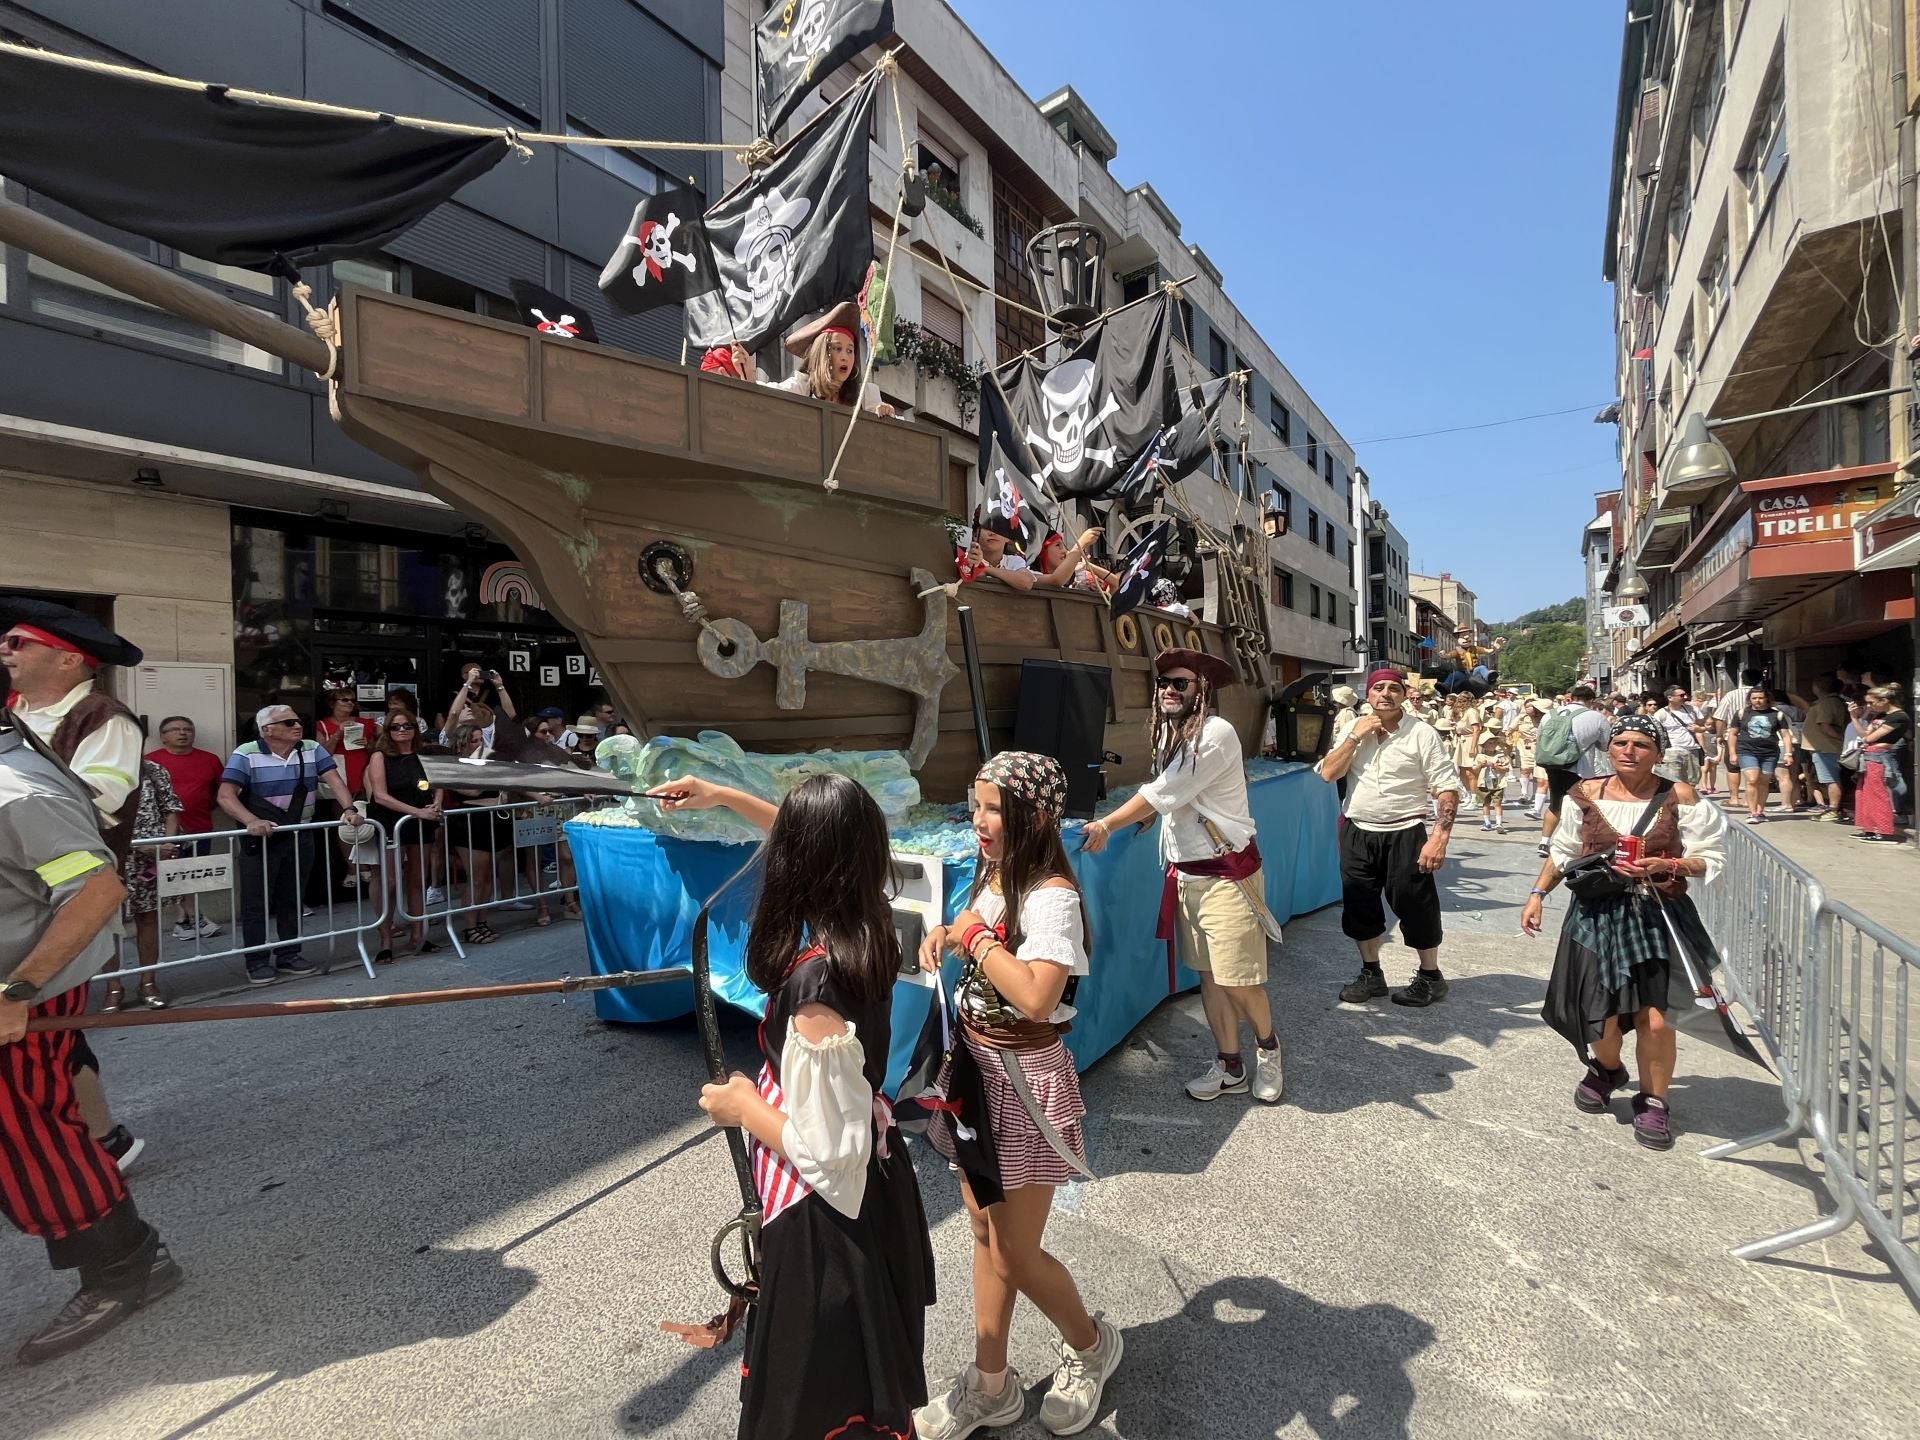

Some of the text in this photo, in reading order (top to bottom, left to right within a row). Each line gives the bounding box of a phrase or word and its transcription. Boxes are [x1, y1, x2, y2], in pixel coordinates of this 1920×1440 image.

[1759, 495, 1809, 512] CASA
[1758, 509, 1878, 537] TRELLE
[1608, 620, 1647, 629] BUNKAI
